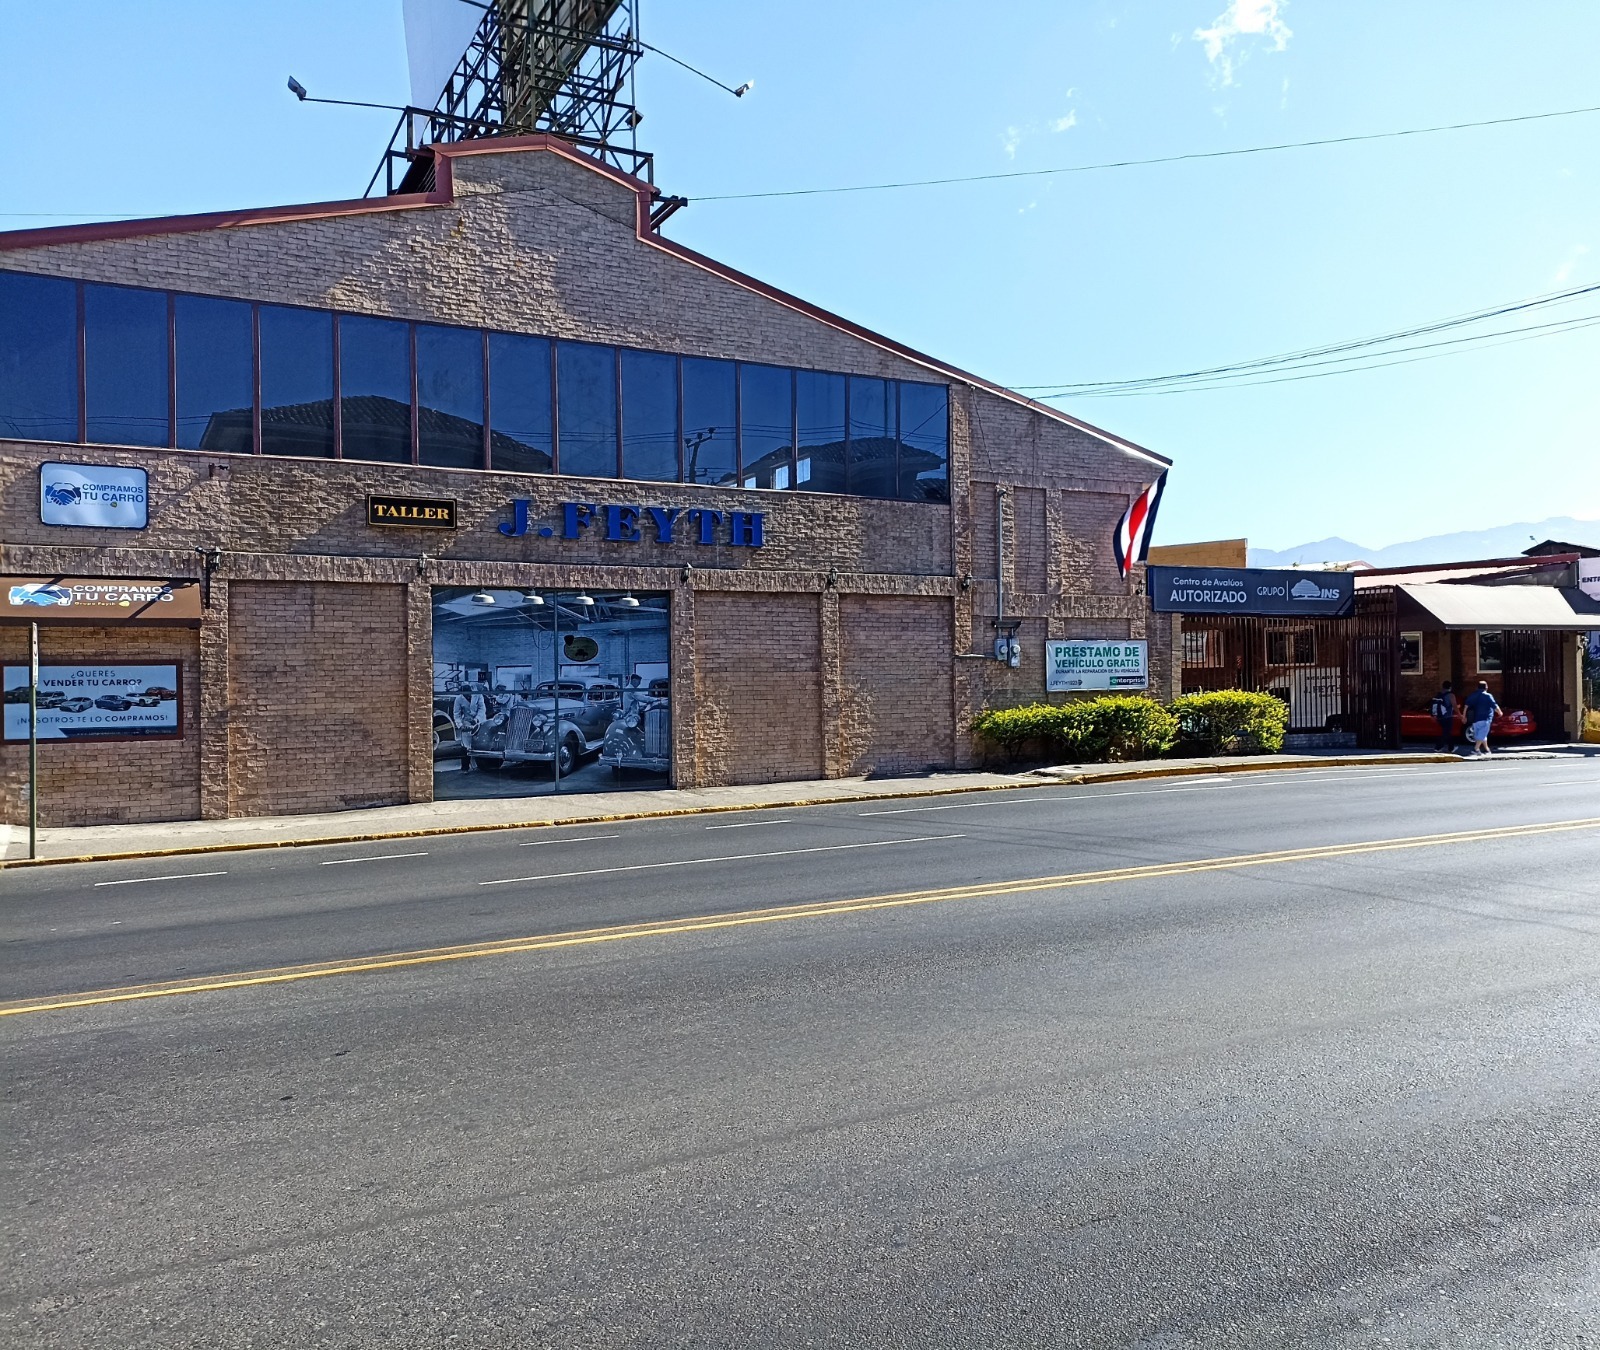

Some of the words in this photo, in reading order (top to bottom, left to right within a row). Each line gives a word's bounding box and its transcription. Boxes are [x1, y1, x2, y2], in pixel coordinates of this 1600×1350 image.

[82, 483, 144, 493] COMPRAMOS
[82, 491, 98, 501] TU
[101, 492, 144, 503] CARRO
[374, 504, 449, 519] TALLER
[1173, 577, 1200, 586] Centro
[1202, 578, 1212, 586] de
[1213, 578, 1243, 587] Avalúos
[73, 585, 173, 594] COMPRAMOS
[1256, 586, 1285, 596] GRUPO
[1321, 588, 1340, 599] INS
[73, 592, 99, 601] TU
[104, 592, 174, 602] CARRO
[1170, 589, 1247, 603] AUTORIZADO
[1055, 644, 1120, 657] PRÉSTAMO
[1124, 646, 1139, 657] DE
[1055, 658, 1104, 668] VEHÍCULO
[1106, 658, 1139, 668] GRATIS
[43, 679, 84, 687] VENDER
[102, 678, 142, 686] CARRO?
[105, 714, 168, 722] COMPRAMOS!
